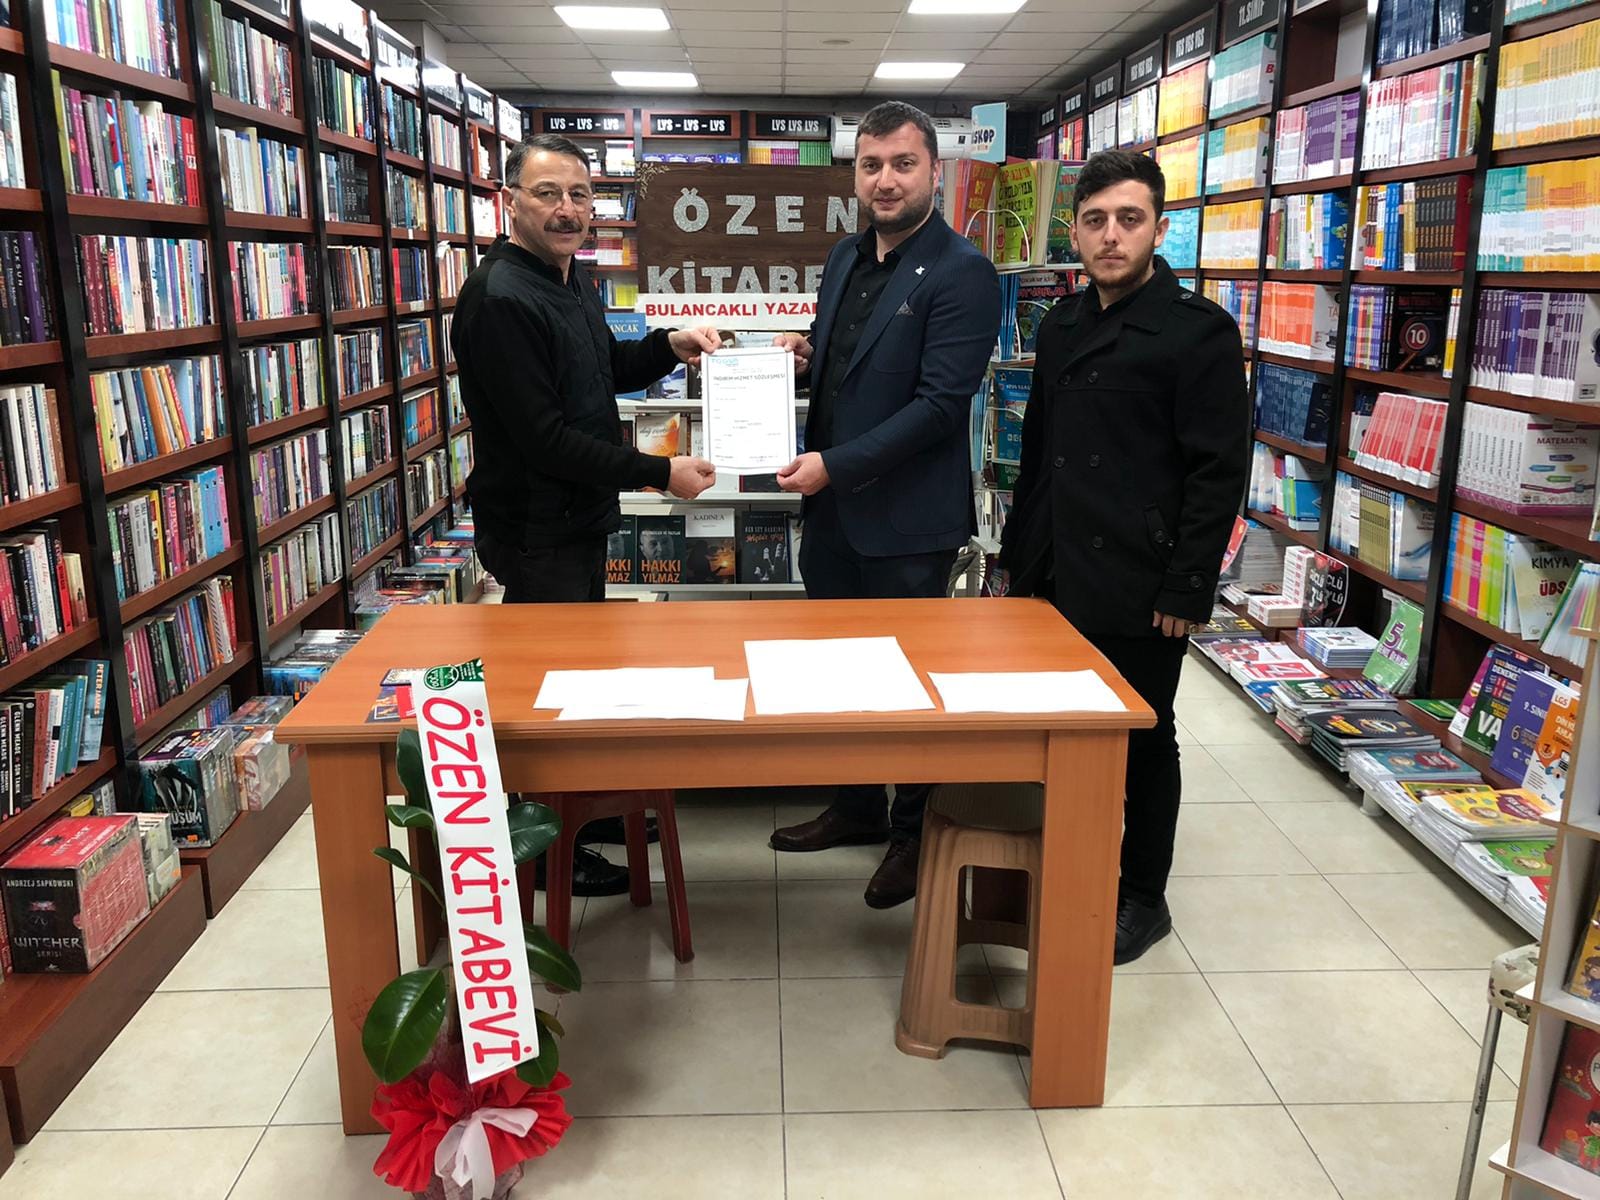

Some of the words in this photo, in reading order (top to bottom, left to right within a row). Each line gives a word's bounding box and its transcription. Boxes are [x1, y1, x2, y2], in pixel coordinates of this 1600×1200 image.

[550, 118, 565, 130] LYS
[577, 118, 592, 130] LYS
[603, 118, 619, 130] LYS
[657, 119, 673, 131] LYS
[683, 119, 699, 131] LYS
[710, 119, 725, 131] LYS
[771, 119, 786, 131] LYS
[788, 120, 802, 131] LYS
[805, 120, 819, 131] LYS
[673, 187, 858, 235] ÖZEN
[646, 261, 825, 294] KİTABE
[645, 303, 757, 316] BULANCAKLI
[765, 302, 817, 315] YAZA
[609, 323, 639, 333] ANCAK
[1410, 329, 1427, 344] 10
[605, 559, 631, 572] KKI
[641, 559, 681, 572] HAKKI
[607, 572, 631, 583] MAZ
[642, 573, 680, 584] YILMAZ
[1383, 620, 1406, 650] 5
[1479, 710, 1503, 741] VA
[1511, 725, 1521, 741] 6
[421, 696, 491, 825] ÖZEN
[171, 810, 202, 824] USUM
[36, 880, 74, 888] SAPKOWSKI
[14, 937, 82, 949] WITCHER
[446, 846, 533, 1064] KİTABEVİ
